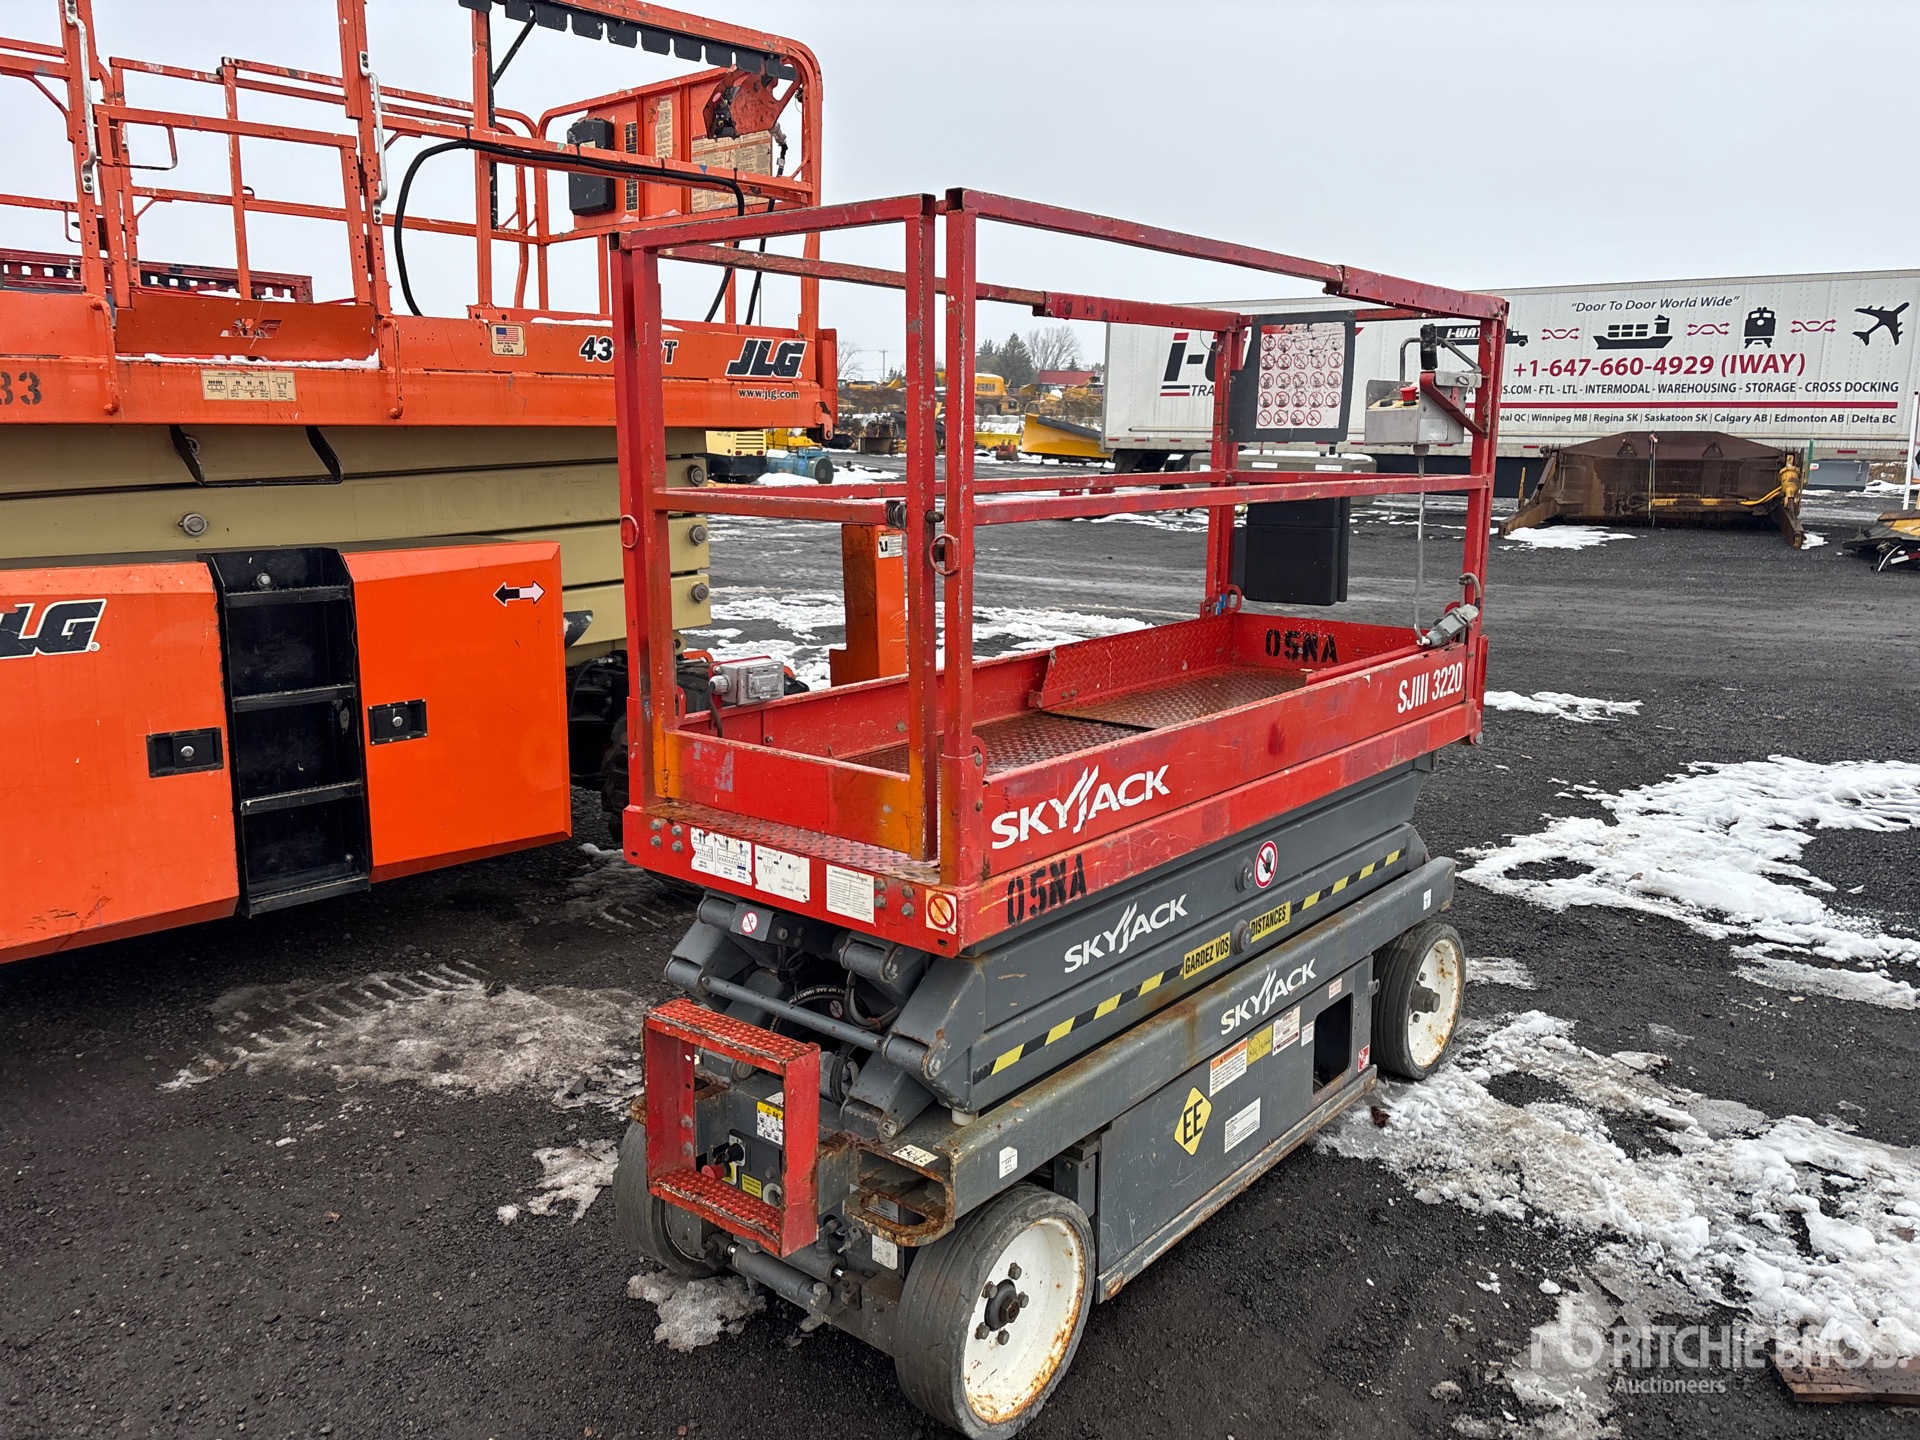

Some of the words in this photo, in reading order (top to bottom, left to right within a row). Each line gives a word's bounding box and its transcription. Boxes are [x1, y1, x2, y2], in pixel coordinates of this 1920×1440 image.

[1608, 300, 1623, 311] To
[1625, 299, 1657, 310] Door
[1660, 297, 1697, 308] World
[725, 338, 808, 378] JLG
[1513, 355, 1715, 378] +1-647-660-4929
[1720, 352, 1806, 378] (IWAY)
[737, 388, 800, 401] www.jlg.com
[1191, 384, 1216, 397] TRA
[1502, 384, 1532, 396] S.COM
[1538, 384, 1556, 395] FTL
[1562, 384, 1578, 395] LTL
[1584, 382, 1651, 395] INTERMODAL
[1657, 382, 1737, 394] WAREHOUSING
[1744, 381, 1796, 394] STORAGE
[1804, 381, 1842, 393] CROSS
[1844, 381, 1900, 393] DOCKING
[1513, 413, 1527, 424] QC
[1531, 413, 1572, 424] Winnipeg
[1573, 413, 1588, 423] MB
[1593, 414, 1624, 425] Regina
[1626, 413, 1639, 423] SK
[1644, 413, 1693, 423] Saskatoon
[1695, 413, 1708, 423] SK
[1714, 413, 1752, 425] Calgary
[1753, 413, 1768, 423] AB
[1774, 413, 1828, 424] Edmonton
[1829, 413, 1845, 424] AB
[1851, 414, 1880, 424] Delta
[1882, 414, 1897, 424] BC
[0, 598, 107, 659] LG
[1397, 669, 1429, 714] SJIII
[1432, 661, 1463, 701] 3220
[990, 764, 1171, 850] SKYJACK
[1064, 893, 1189, 974] SKYJACK
[1251, 909, 1287, 938] DISTANCES
[1185, 947, 1214, 975] GARDEZ
[1215, 936, 1230, 957] VOS
[1221, 958, 1317, 1036] SKYJACK
[1183, 1098, 1204, 1146] EE
